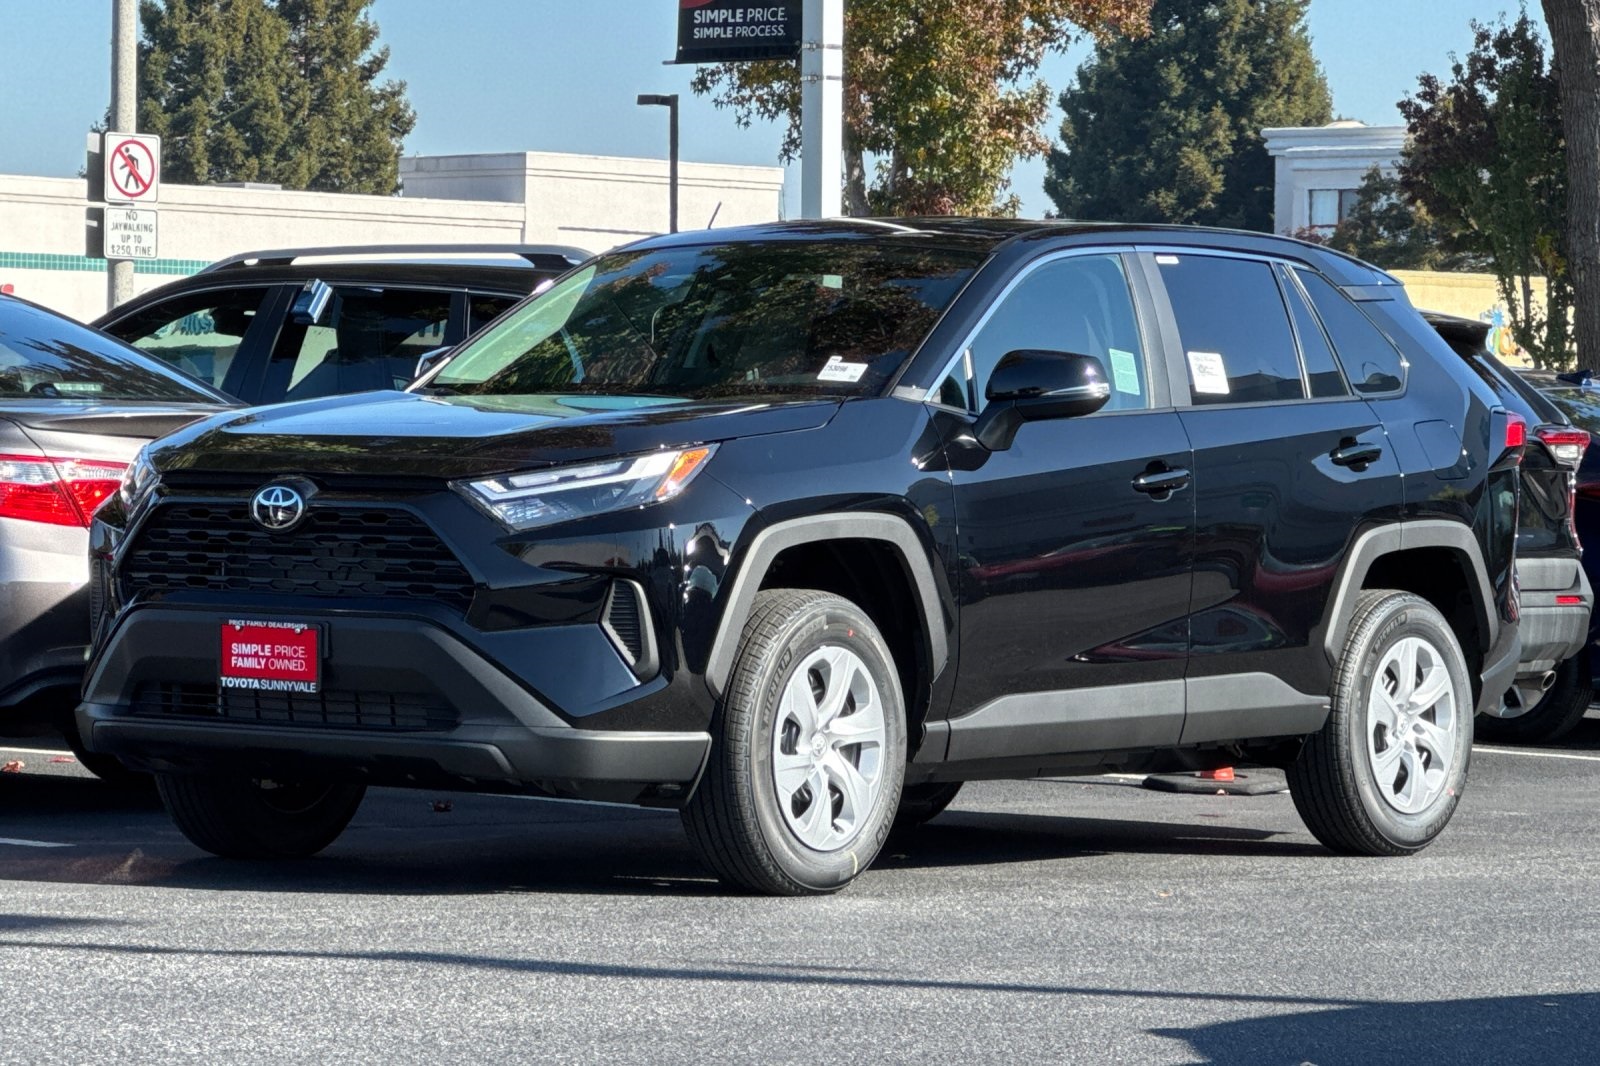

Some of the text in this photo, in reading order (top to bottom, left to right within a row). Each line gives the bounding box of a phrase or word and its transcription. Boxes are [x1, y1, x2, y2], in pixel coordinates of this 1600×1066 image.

[693, 7, 788, 24] SIMPLE PRICE.
[693, 24, 786, 39] SIMPLE PROCESS.
[125, 211, 138, 221] NO
[111, 222, 154, 233] JAYWALKING
[121, 234, 143, 244] UP TO
[135, 245, 152, 256] FINE
[246, 620, 267, 628] FAMILY
[267, 621, 308, 630] DEALERSHIPS
[231, 642, 308, 658] SIMPLE PRICE.
[231, 656, 308, 672] FAMILY OWNED.
